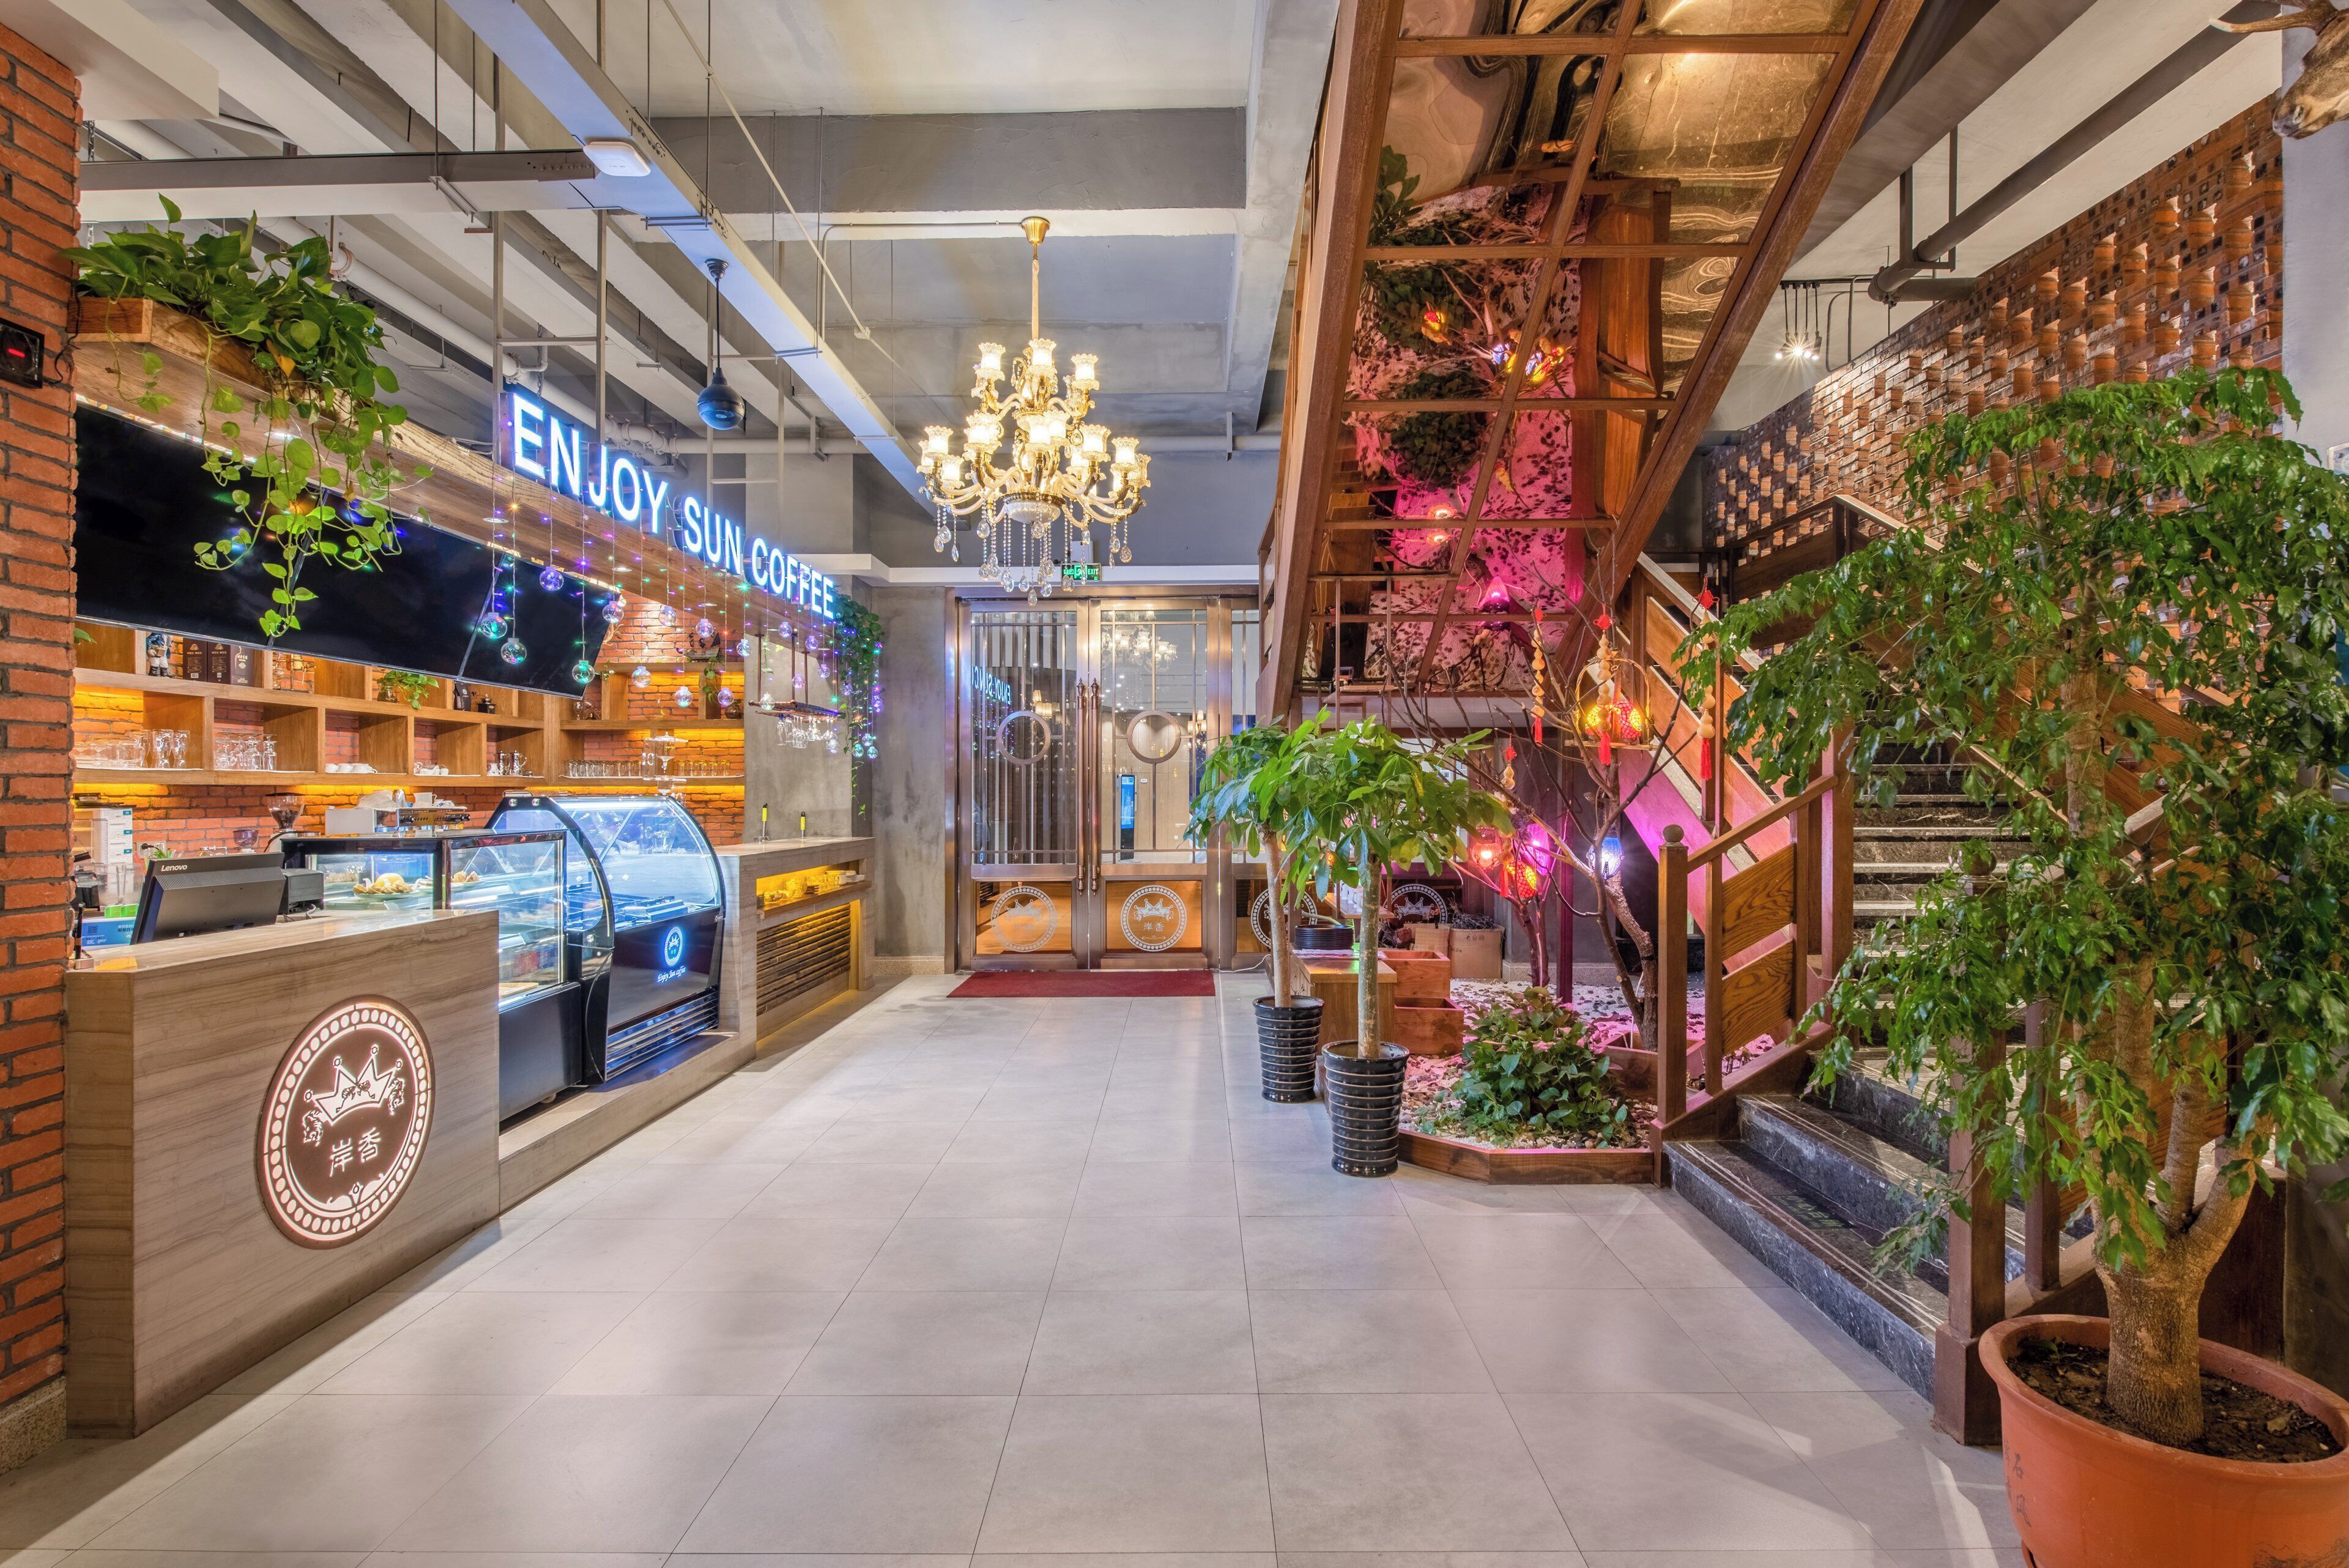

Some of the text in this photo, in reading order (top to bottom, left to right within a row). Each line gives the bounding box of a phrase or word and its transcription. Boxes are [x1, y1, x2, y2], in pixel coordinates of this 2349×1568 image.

[513, 393, 834, 619] ENJOY SUN COFFEE
[1143, 922, 1164, 932] 岸香
[657, 973, 669, 983] Enjoy
[329, 1127, 381, 1177] 岸香
